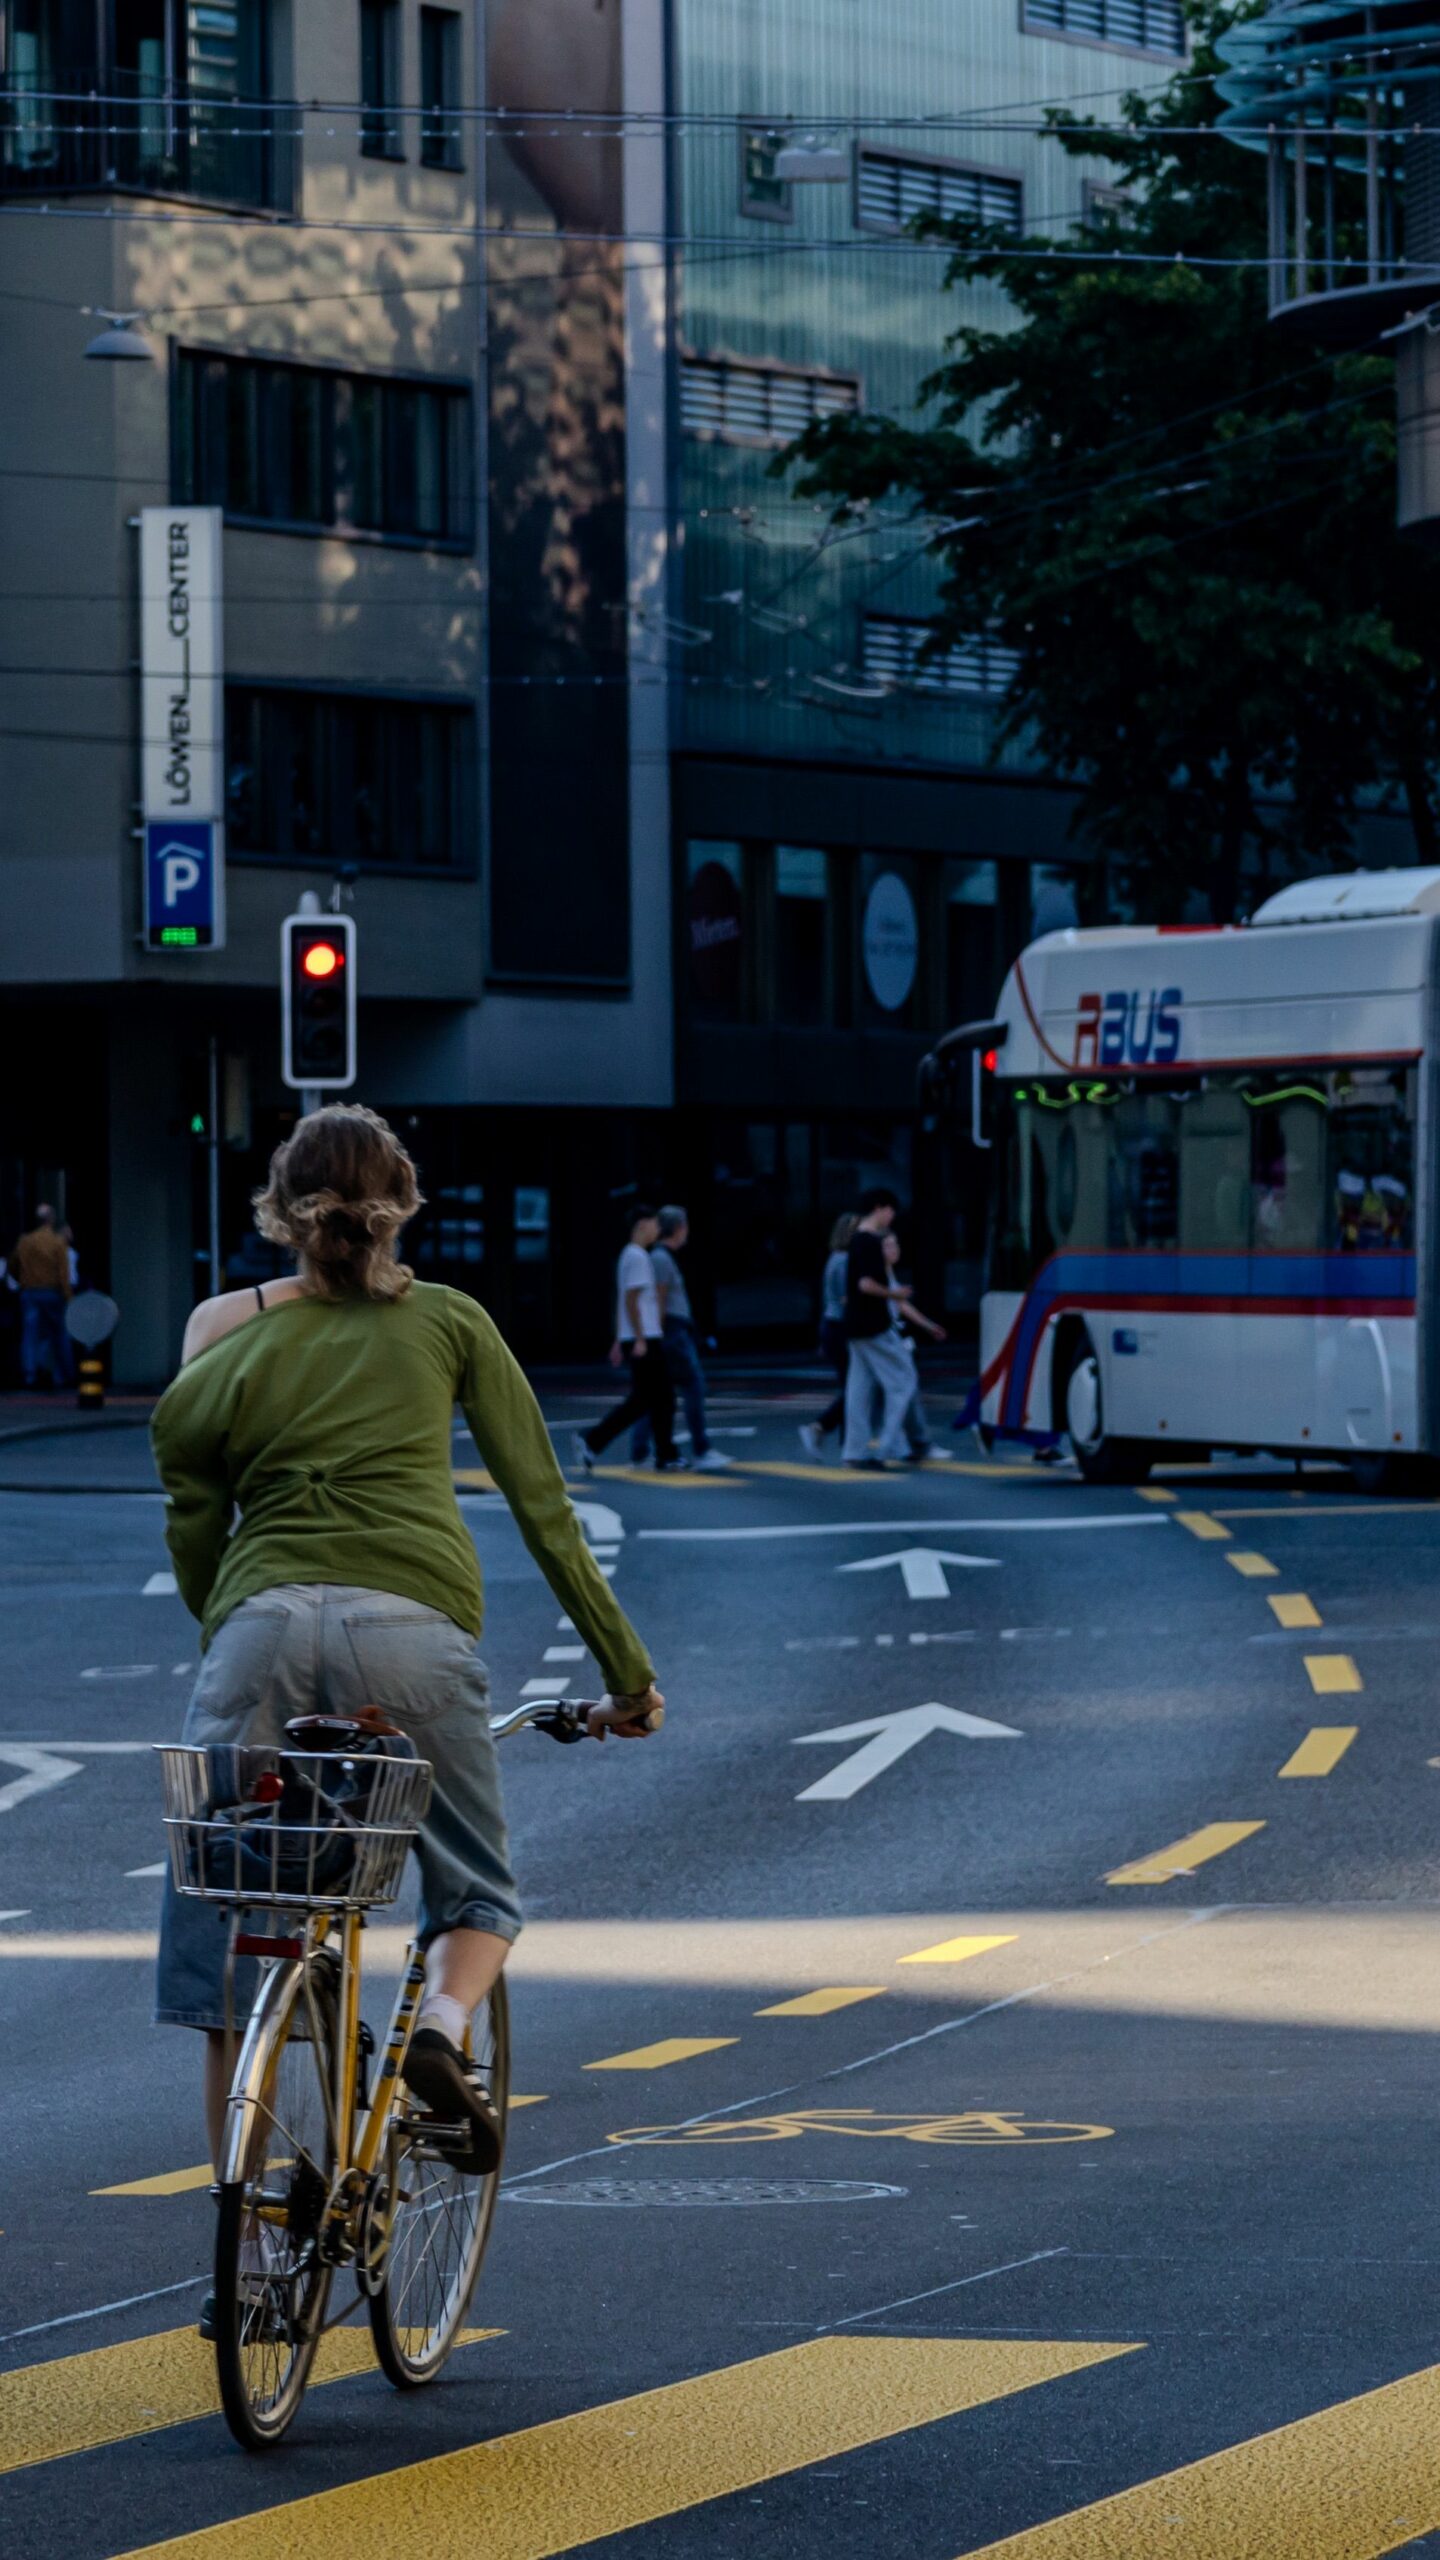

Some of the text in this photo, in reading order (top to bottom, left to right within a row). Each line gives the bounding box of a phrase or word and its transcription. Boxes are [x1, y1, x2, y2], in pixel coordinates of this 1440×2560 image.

[168, 522, 191, 637] CENTER
[166, 857, 199, 906] P
[1075, 988, 1181, 1066] RBUS
